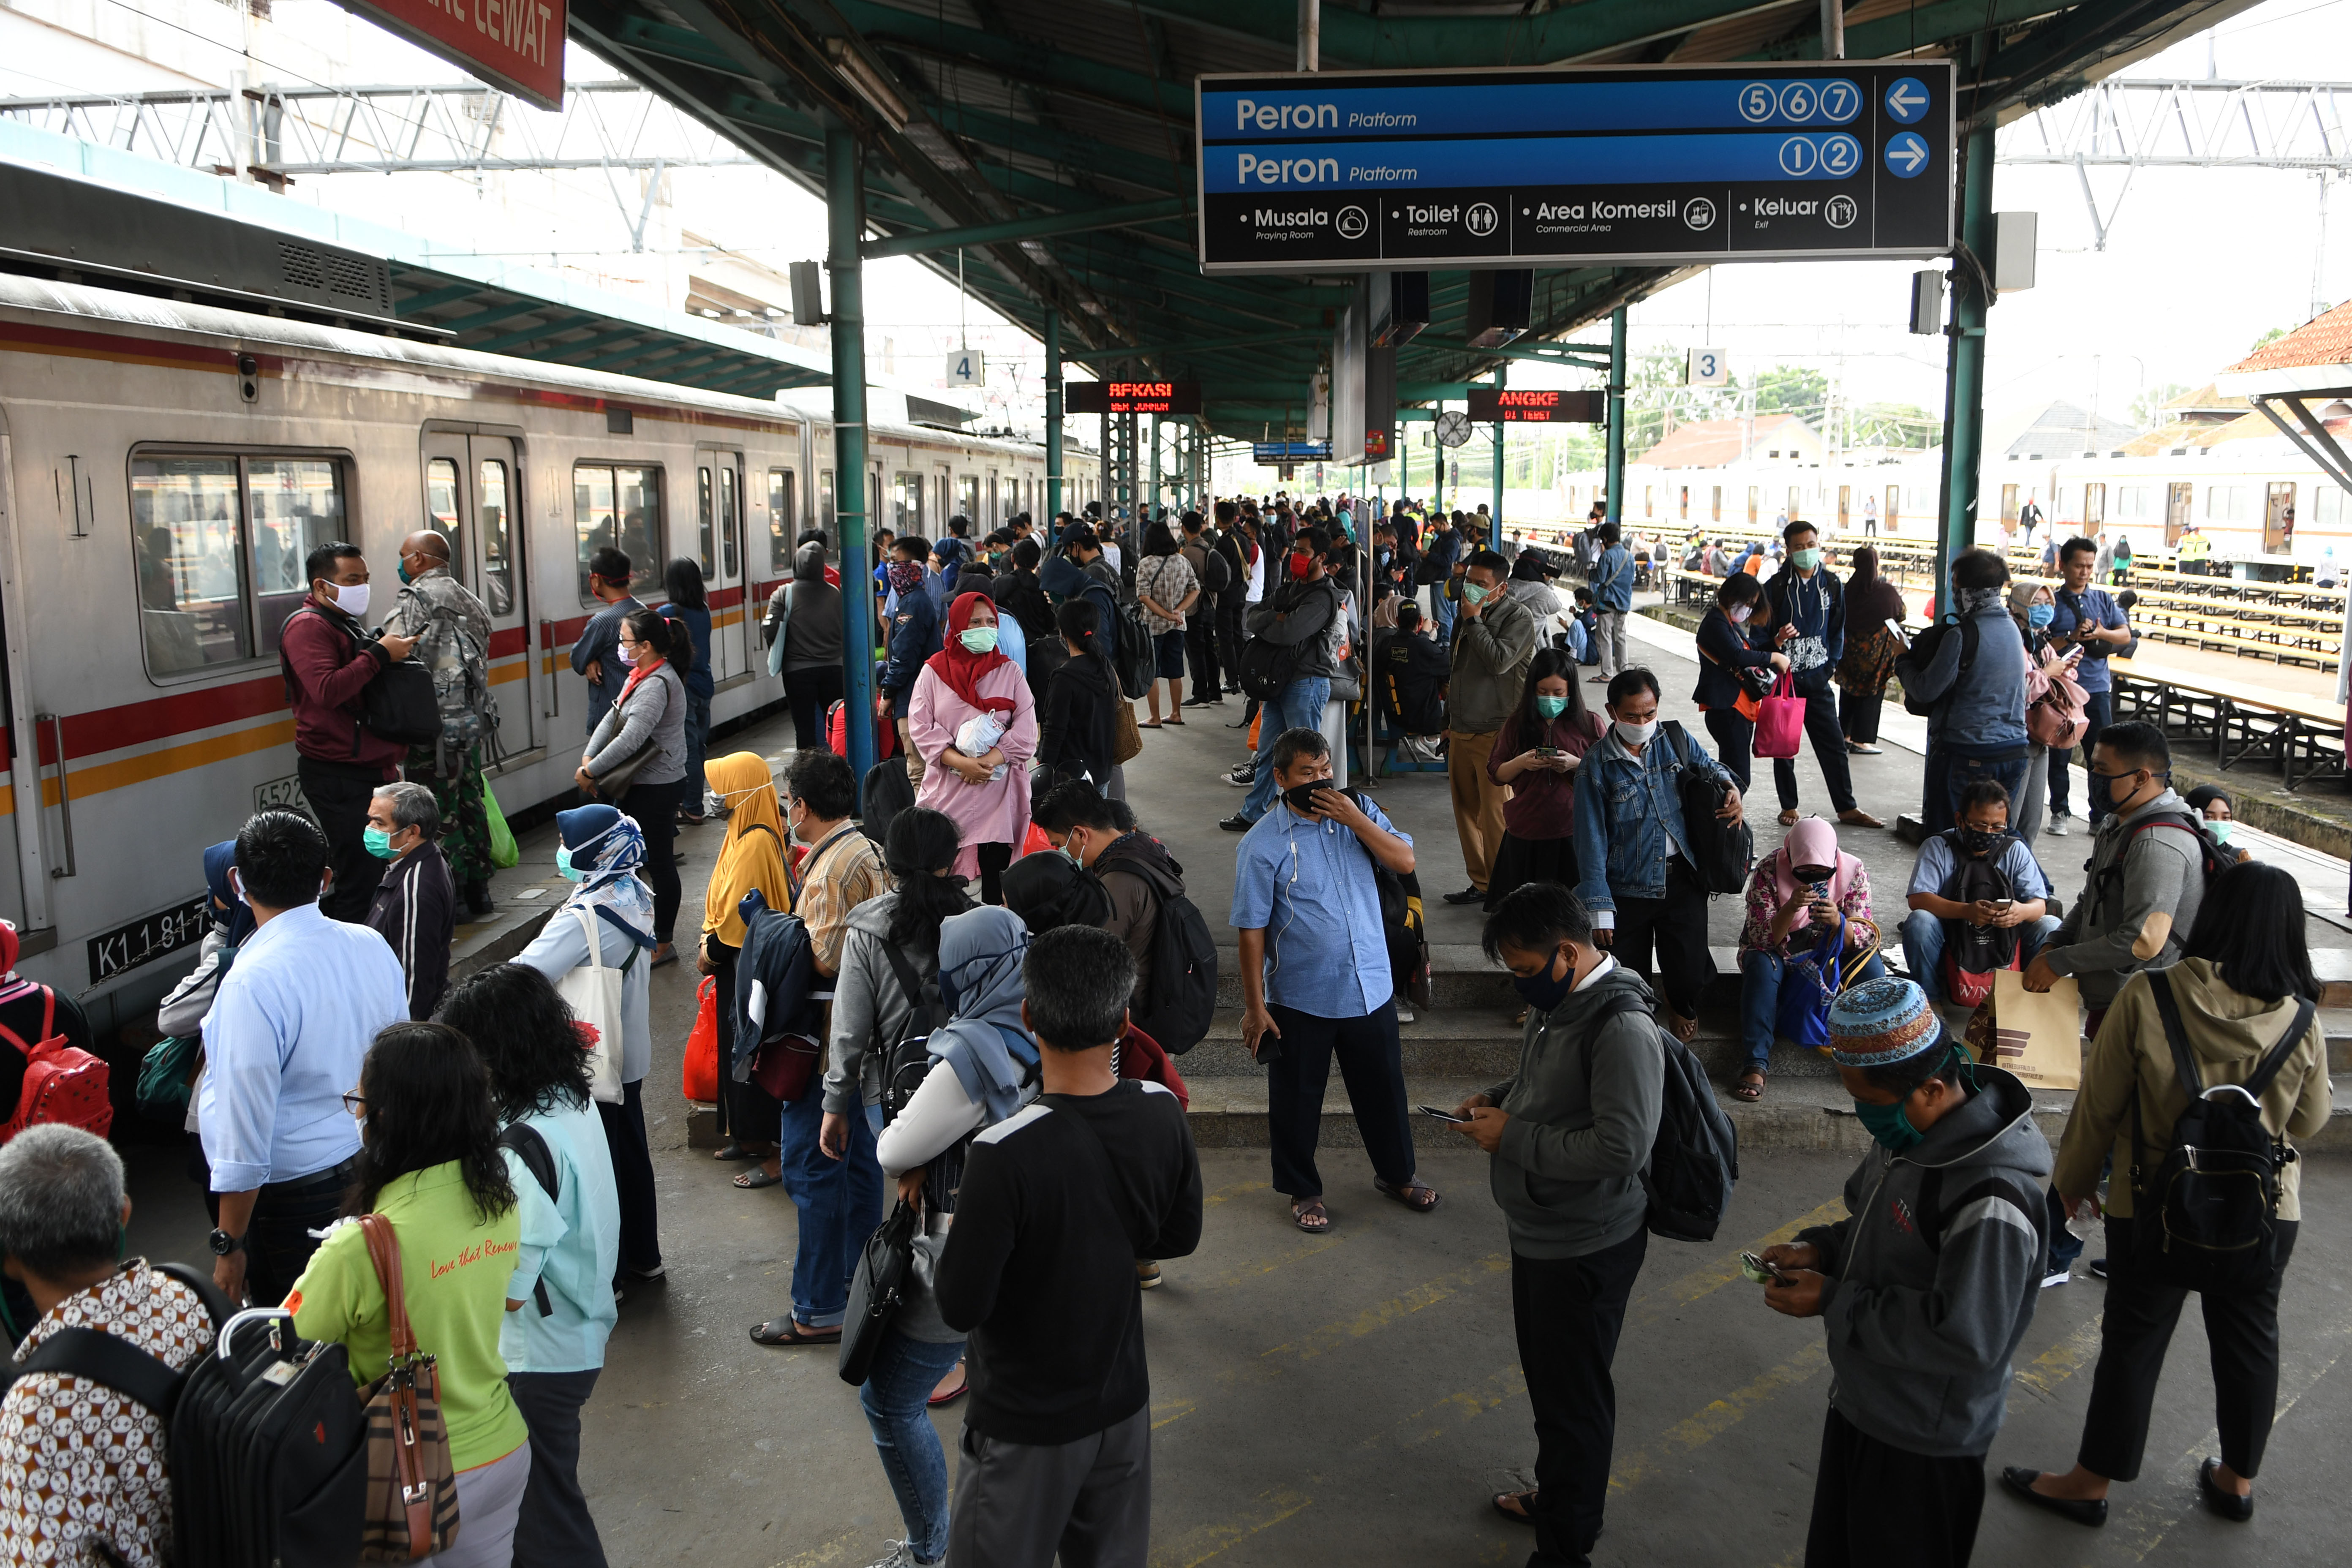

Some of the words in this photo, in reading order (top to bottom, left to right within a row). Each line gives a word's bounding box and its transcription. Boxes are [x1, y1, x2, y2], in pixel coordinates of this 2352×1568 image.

[1237, 99, 1338, 131] Peron
[1348, 112, 1417, 128] Platform
[1749, 89, 1766, 115] 5
[1790, 89, 1805, 115] 6
[1832, 89, 1847, 114] 7
[1238, 153, 1339, 184] Peron
[1349, 166, 1418, 182] Platform
[1794, 144, 1802, 169] 1
[1832, 142, 1847, 167] 2
[1406, 204, 1460, 223] Toilet
[1536, 202, 1584, 220] Area
[1592, 199, 1676, 219] Komersil
[1754, 197, 1819, 216] Keluar
[1255, 207, 1328, 227] Musala
[1755, 220, 1769, 229] Exit
[1256, 231, 1288, 241] Praying
[1289, 231, 1314, 239] Room
[1408, 228, 1448, 236] Restroom
[1536, 224, 1589, 233] Commercial
[1590, 224, 1612, 232] Area
[956, 357, 972, 380] 4
[1701, 354, 1715, 377] 3
[1498, 392, 1559, 406] ANGKE
[431, 1259, 455, 1279] Love
[459, 1244, 481, 1267] that
